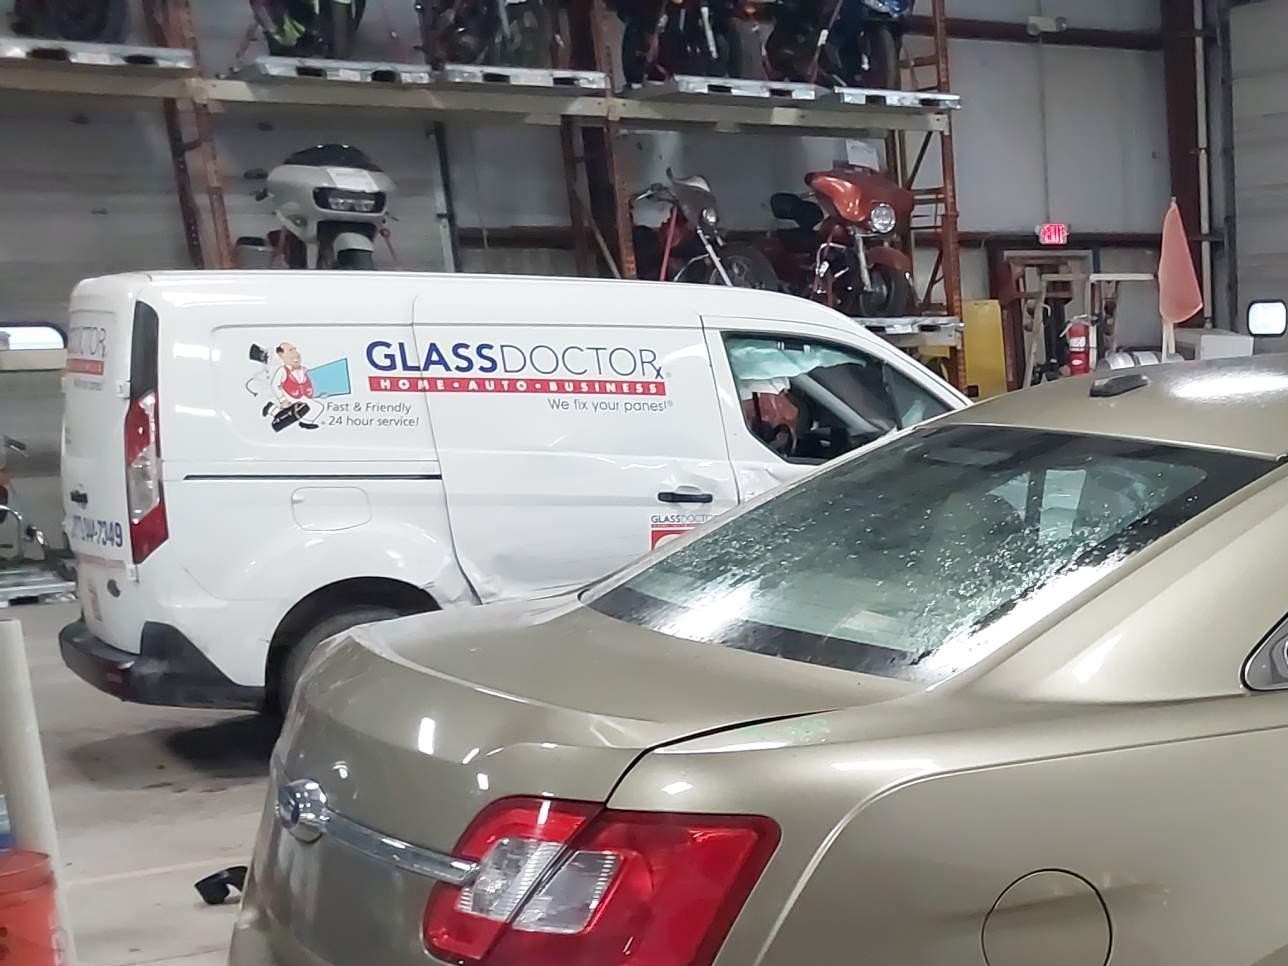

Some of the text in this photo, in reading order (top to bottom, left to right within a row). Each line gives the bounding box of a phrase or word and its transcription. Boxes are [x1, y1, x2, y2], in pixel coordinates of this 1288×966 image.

[468, 380, 527, 391] AUTO
[549, 382, 657, 393] BUSINESS
[327, 402, 411, 414] Fast & Friendly
[547, 399, 569, 410] We
[575, 399, 588, 411] fix
[592, 402, 619, 413] your
[328, 416, 419, 427] 24 hour service!
